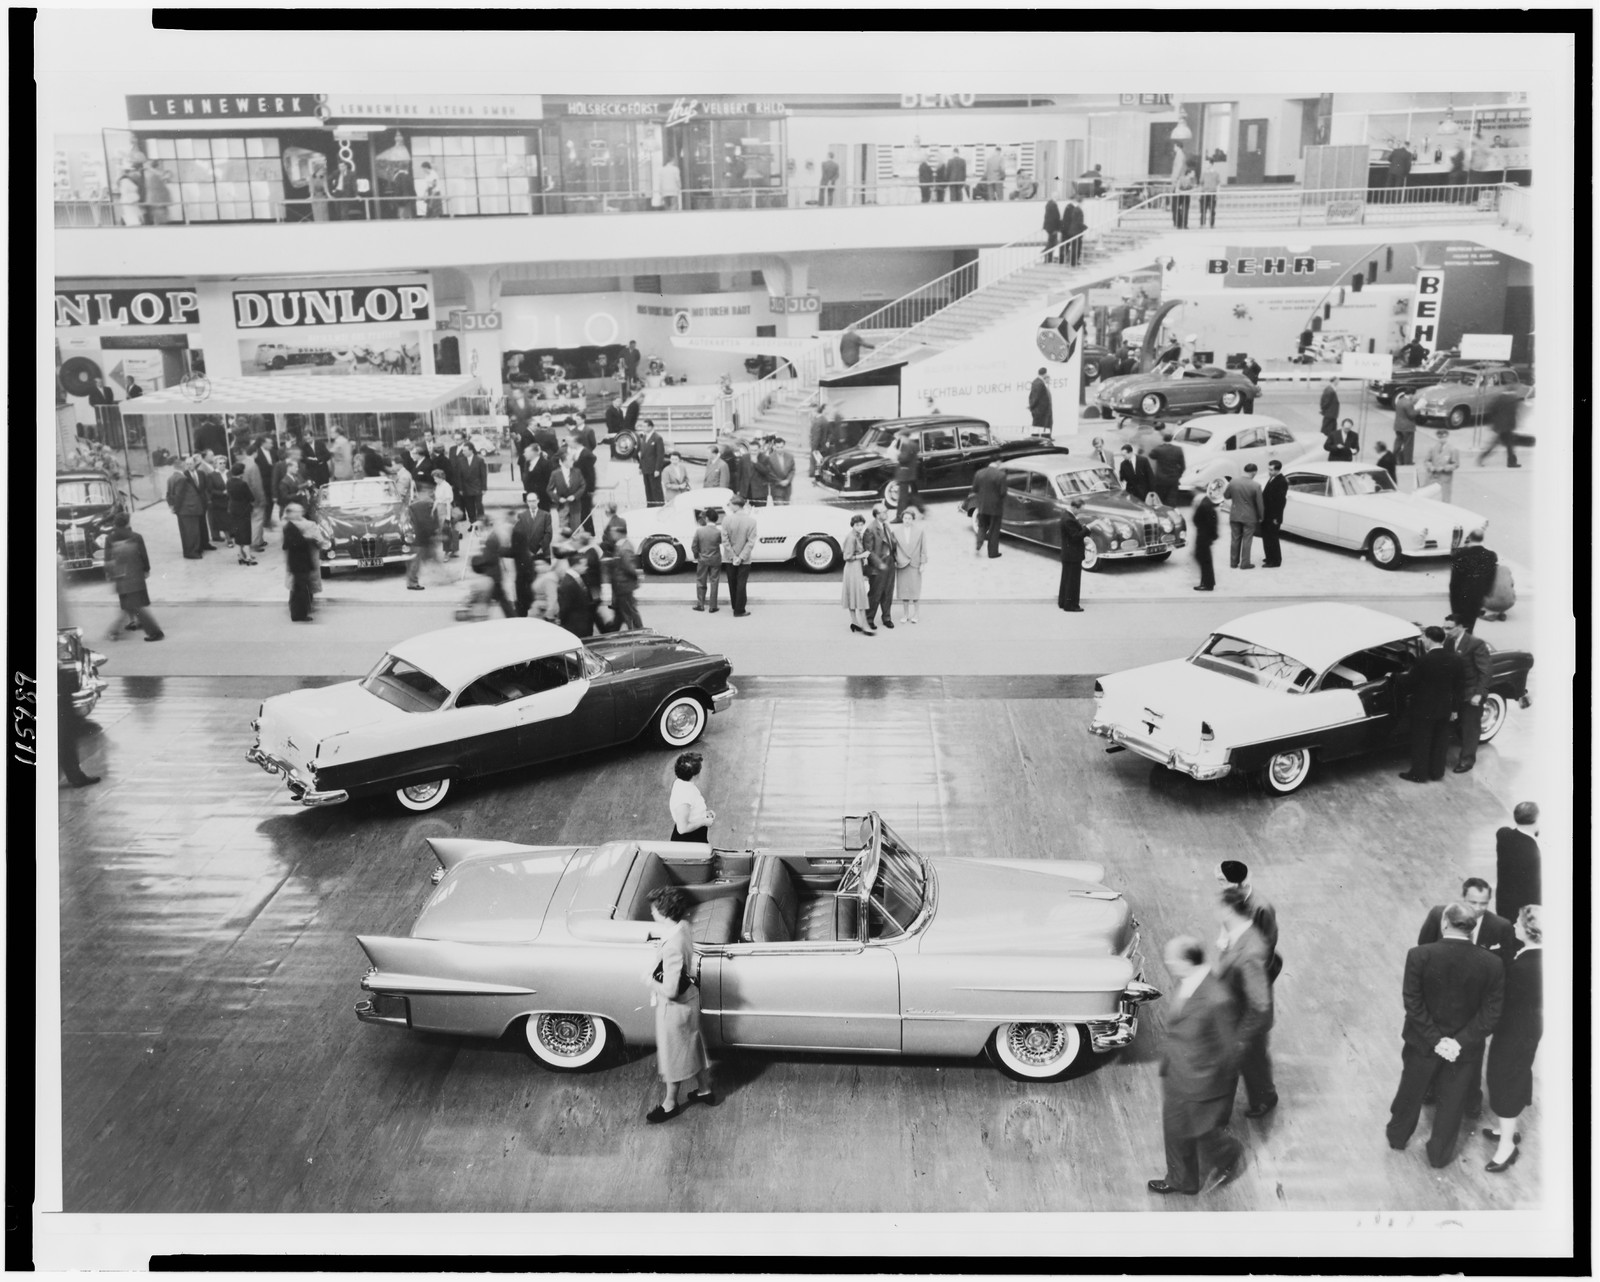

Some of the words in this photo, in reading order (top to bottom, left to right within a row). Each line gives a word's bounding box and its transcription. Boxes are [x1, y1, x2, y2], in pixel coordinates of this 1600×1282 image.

[149, 97, 302, 116] LENNEWERK
[340, 104, 419, 116] LENNEWERK
[429, 105, 475, 116] ALTENA
[702, 102, 748, 115] VELBERT
[234, 286, 429, 327] DUNLOP
[917, 385, 973, 400] LEICHTBAU
[976, 383, 1012, 395] DURCH
[13, 671, 37, 766] 115989
